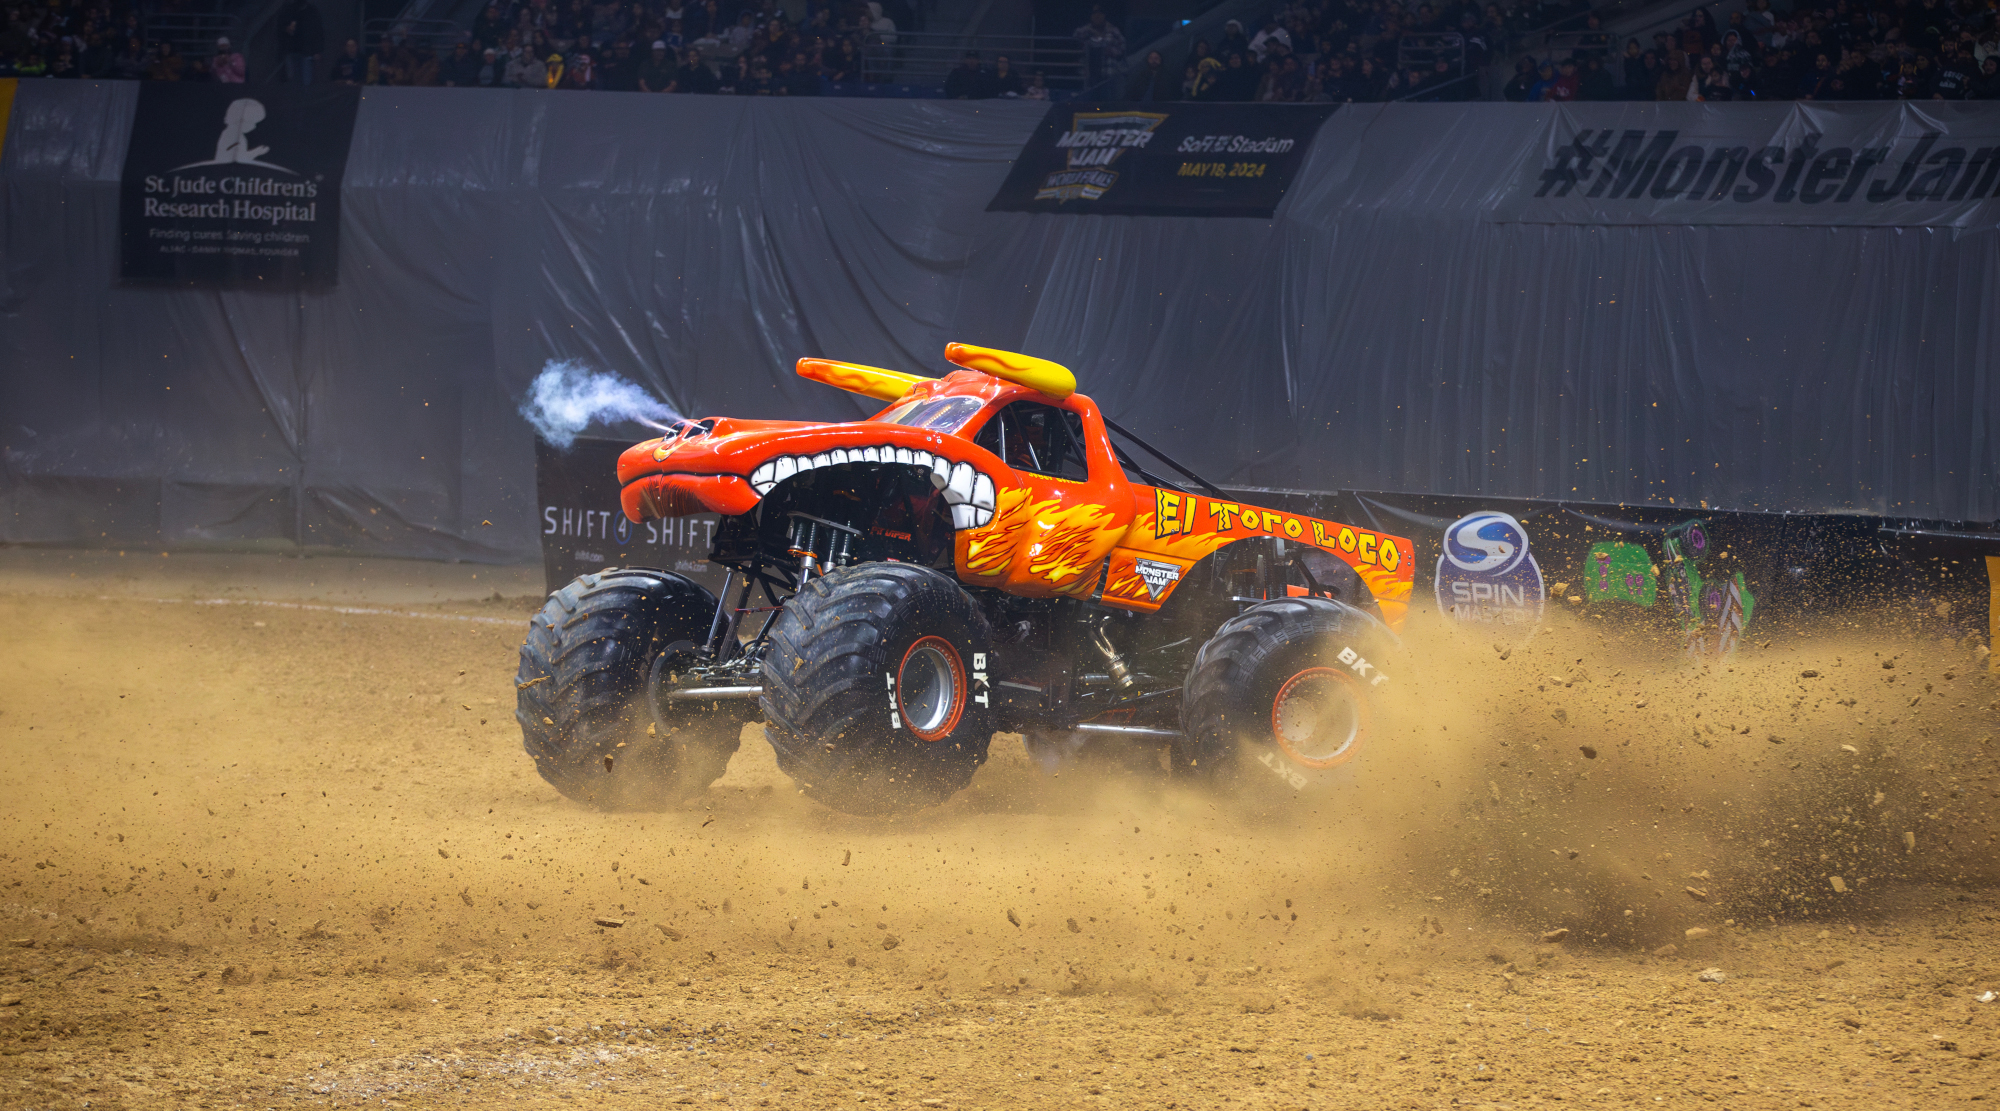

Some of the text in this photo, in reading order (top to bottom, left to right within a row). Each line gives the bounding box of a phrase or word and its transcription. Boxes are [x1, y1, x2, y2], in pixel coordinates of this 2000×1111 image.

[1056, 129, 1155, 148] MONSTER
[1069, 148, 1118, 166] JAM
[1177, 162, 1267, 178] MAY 18, 2024
[145, 175, 317, 198] St. Jude Children's
[144, 198, 316, 225] Research Hospital
[150, 228, 190, 241] Finding
[870, 526, 911, 542] PIT VIPER
[1135, 565, 1180, 581] MONSTER
[1146, 575, 1167, 586] JAM
[1451, 581, 1525, 607] SPIN
[1336, 646, 1390, 687] BKT
[972, 652, 991, 709] BKT
[885, 671, 902, 729] BKT
[1257, 752, 1309, 791] BKT
